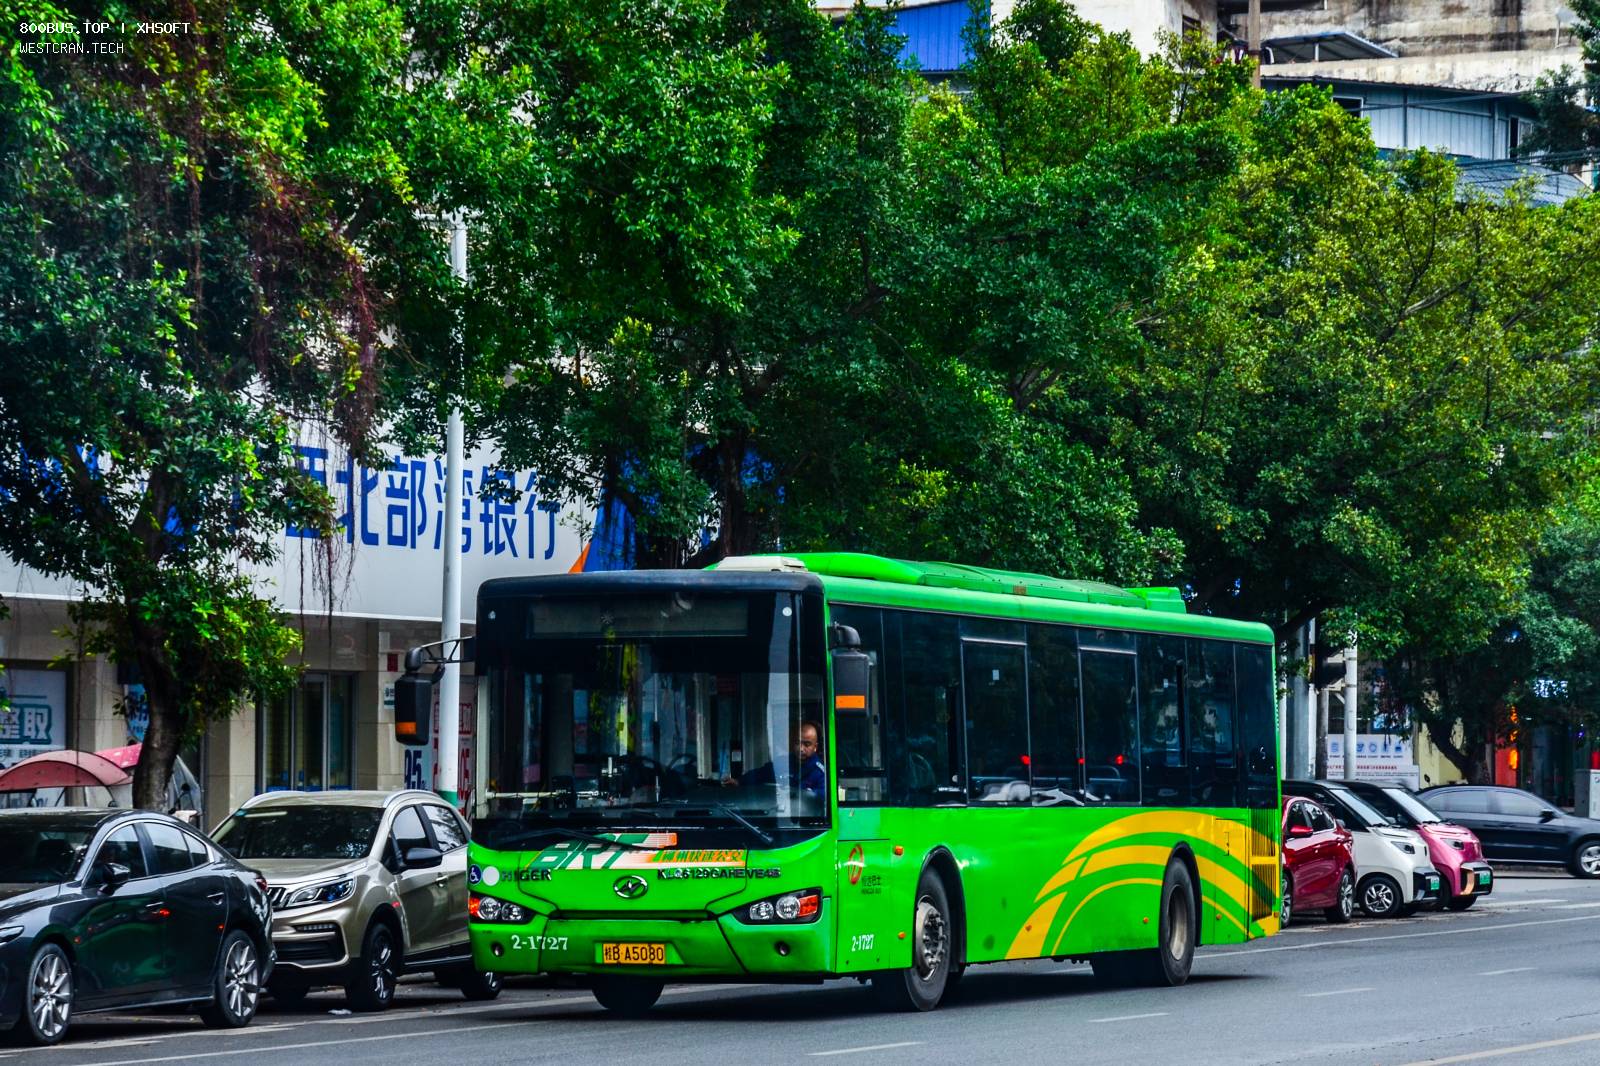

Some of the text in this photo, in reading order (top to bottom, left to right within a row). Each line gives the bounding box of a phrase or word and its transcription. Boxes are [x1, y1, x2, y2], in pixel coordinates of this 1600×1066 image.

[501, 869, 552, 881] HIGER
[511, 934, 569, 951] 2-1727
[851, 934, 875, 952] 2-1727
